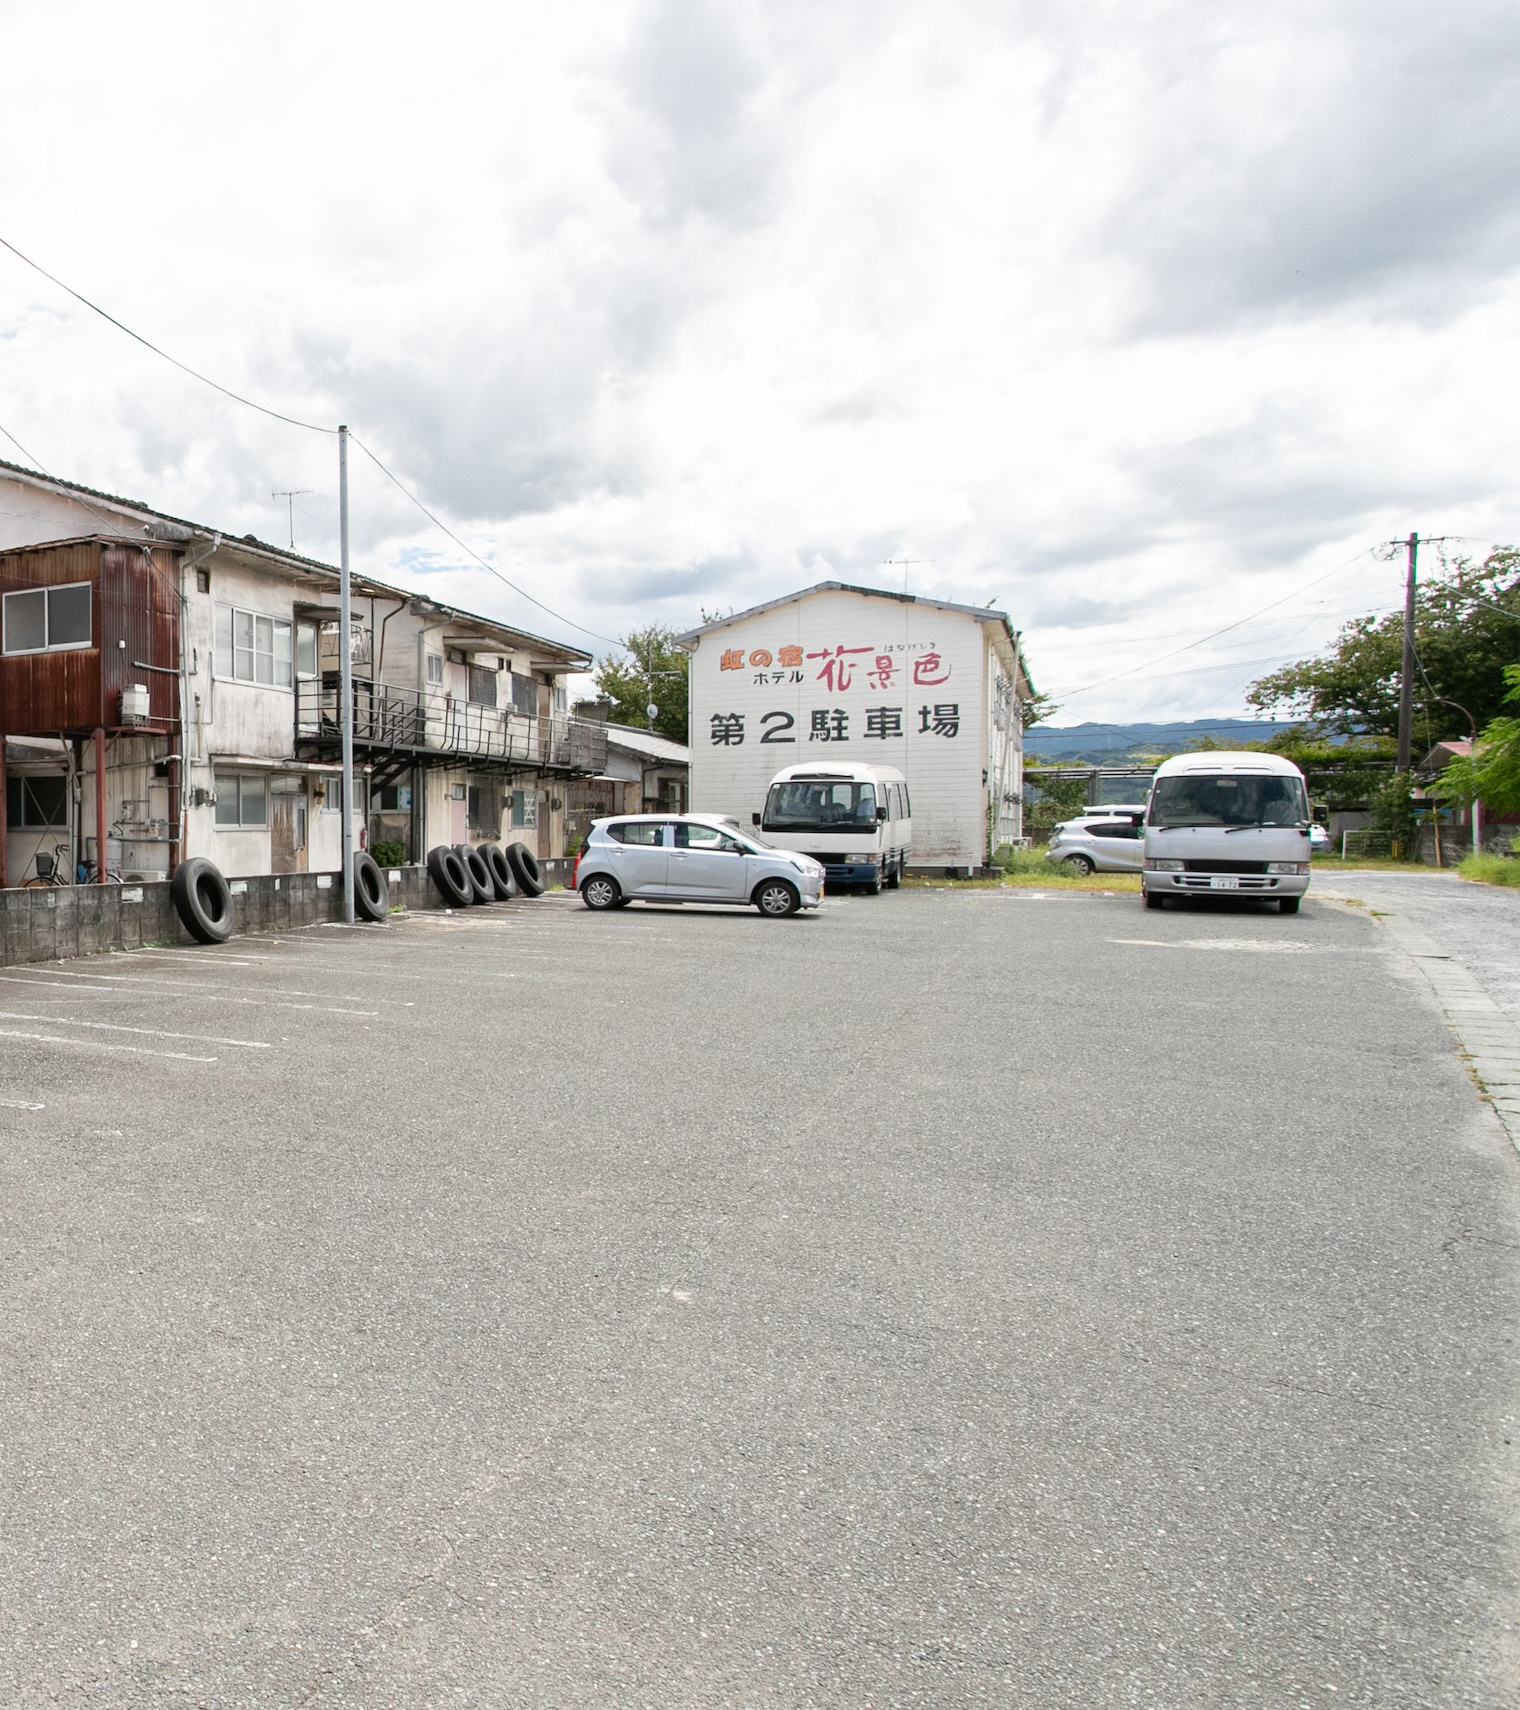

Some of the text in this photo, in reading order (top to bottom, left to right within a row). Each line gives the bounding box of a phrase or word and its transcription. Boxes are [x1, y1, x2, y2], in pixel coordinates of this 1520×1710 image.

[720, 646, 803, 672] 虹の宿
[806, 645, 952, 692] 花景色
[753, 671, 804, 685] ホテル
[710, 704, 960, 746] 第2駐車場
